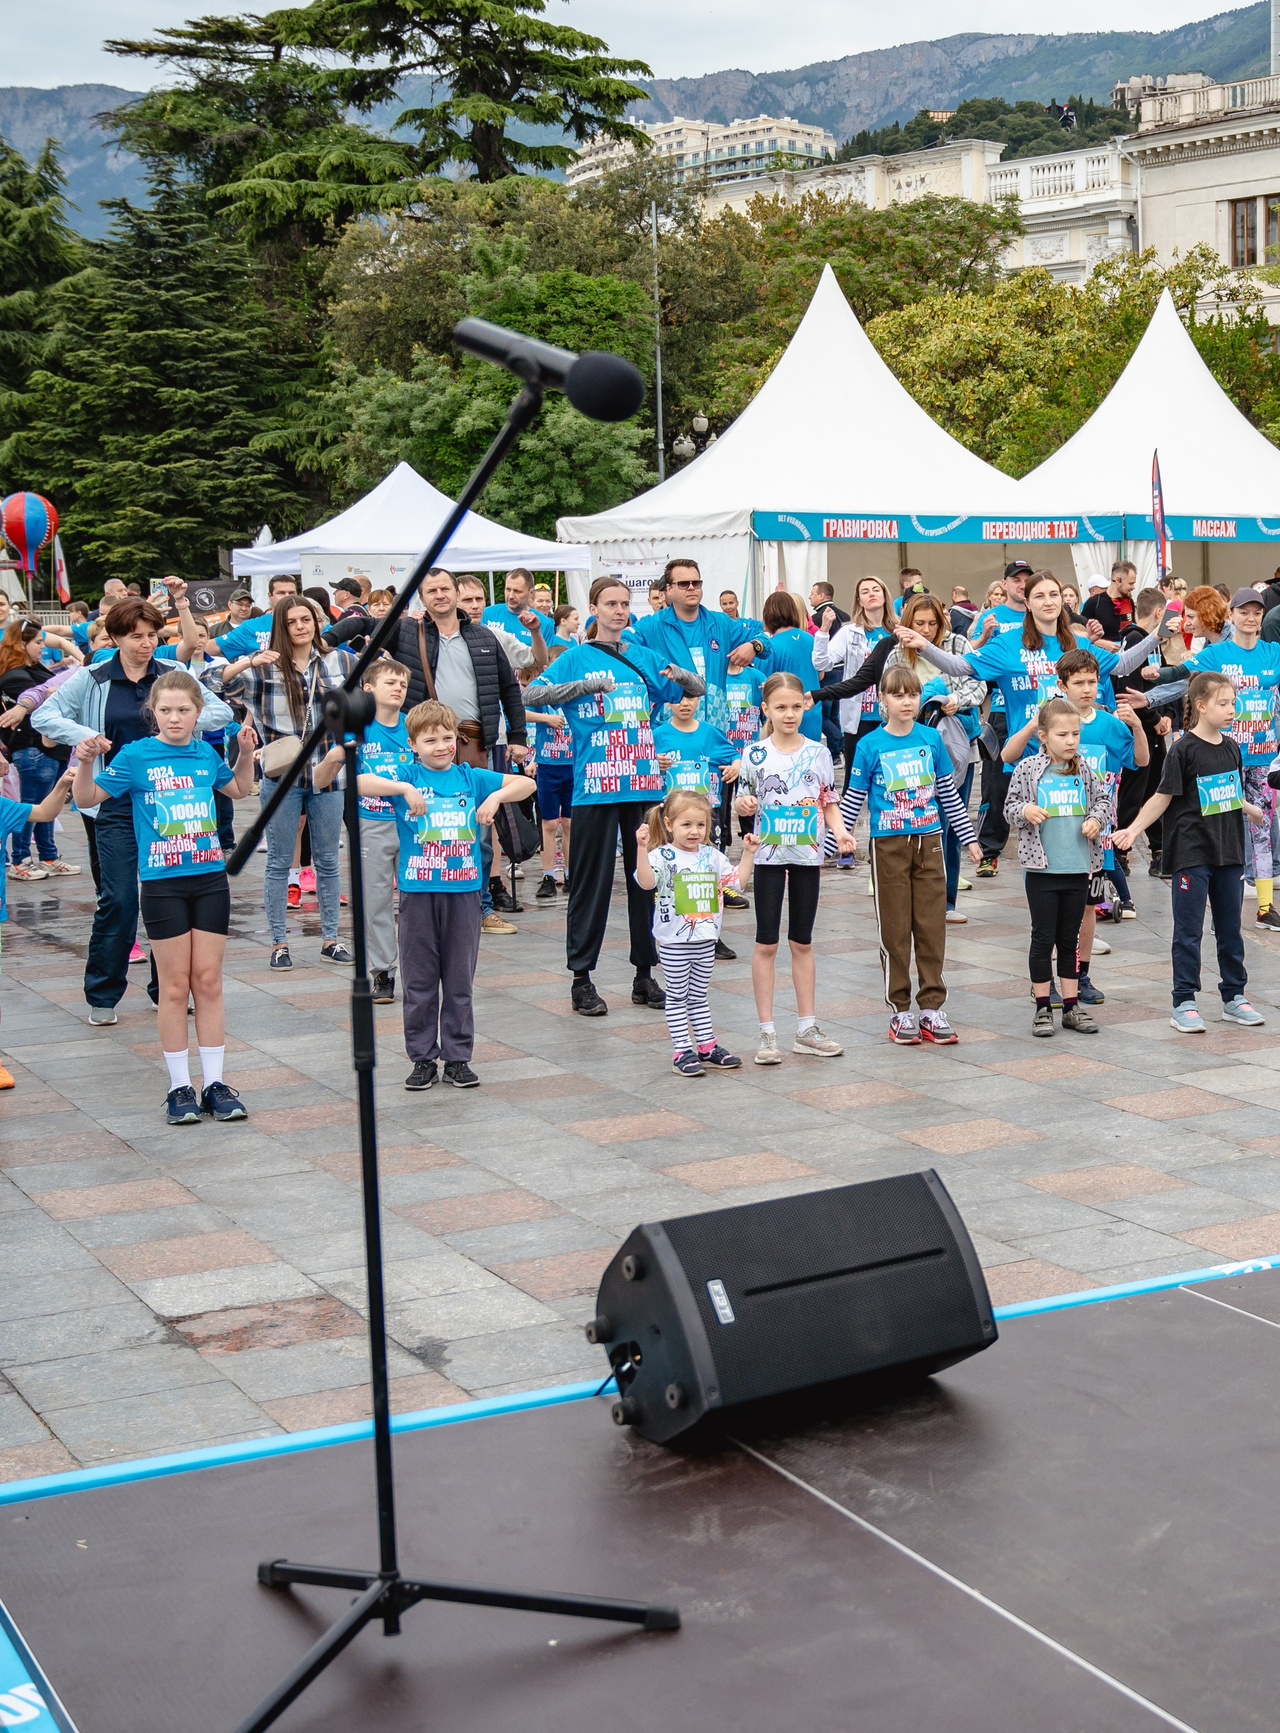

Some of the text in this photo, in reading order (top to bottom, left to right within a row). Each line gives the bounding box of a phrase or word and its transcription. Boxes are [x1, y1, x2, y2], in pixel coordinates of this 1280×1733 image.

[823, 518, 899, 539] ГРАВИРОВКА
[982, 520, 1051, 541] ПЕРЕВОДНОЕ
[1052, 520, 1078, 539] ТАТУ
[1192, 519, 1237, 538] МАССАЖ
[1020, 648, 1047, 663] 2024
[1221, 664, 1243, 676] 2024
[1011, 674, 1038, 691] #ЗАБ
[1230, 675, 1260, 687] МЕЧТА
[578, 701, 604, 719] #ЗАБ
[613, 696, 643, 711] 10048
[1245, 699, 1268, 712] 10132
[591, 728, 628, 747] #ЗАБЕГ
[362, 742, 382, 754] 2024
[147, 765, 175, 782] 2024
[585, 759, 637, 779] #ЛЮБОВЬ
[895, 759, 924, 777] 10171
[153, 775, 195, 792] #МЕЧТА
[584, 776, 621, 794] #ЗАБЕГ
[676, 771, 701, 785] 10101
[884, 790, 908, 801] #ЗАБЕГ
[1048, 790, 1080, 805] 10072
[1209, 784, 1237, 802] 10202
[169, 801, 209, 822] 10040
[429, 811, 466, 828] 10250
[774, 817, 805, 833] 10173
[878, 819, 904, 831] #ЗАБЕГ
[149, 838, 197, 855] #ЛЮБОВЬ
[423, 844, 471, 857] #ГОРДОСТЬ
[147, 852, 183, 868] #ЗАБЕГ
[408, 856, 447, 869] #ЛЮБОВЬ
[405, 868, 432, 881] #ЗАБЕГ
[686, 882, 715, 899] 10173
[711, 1284, 732, 1318] FBT
